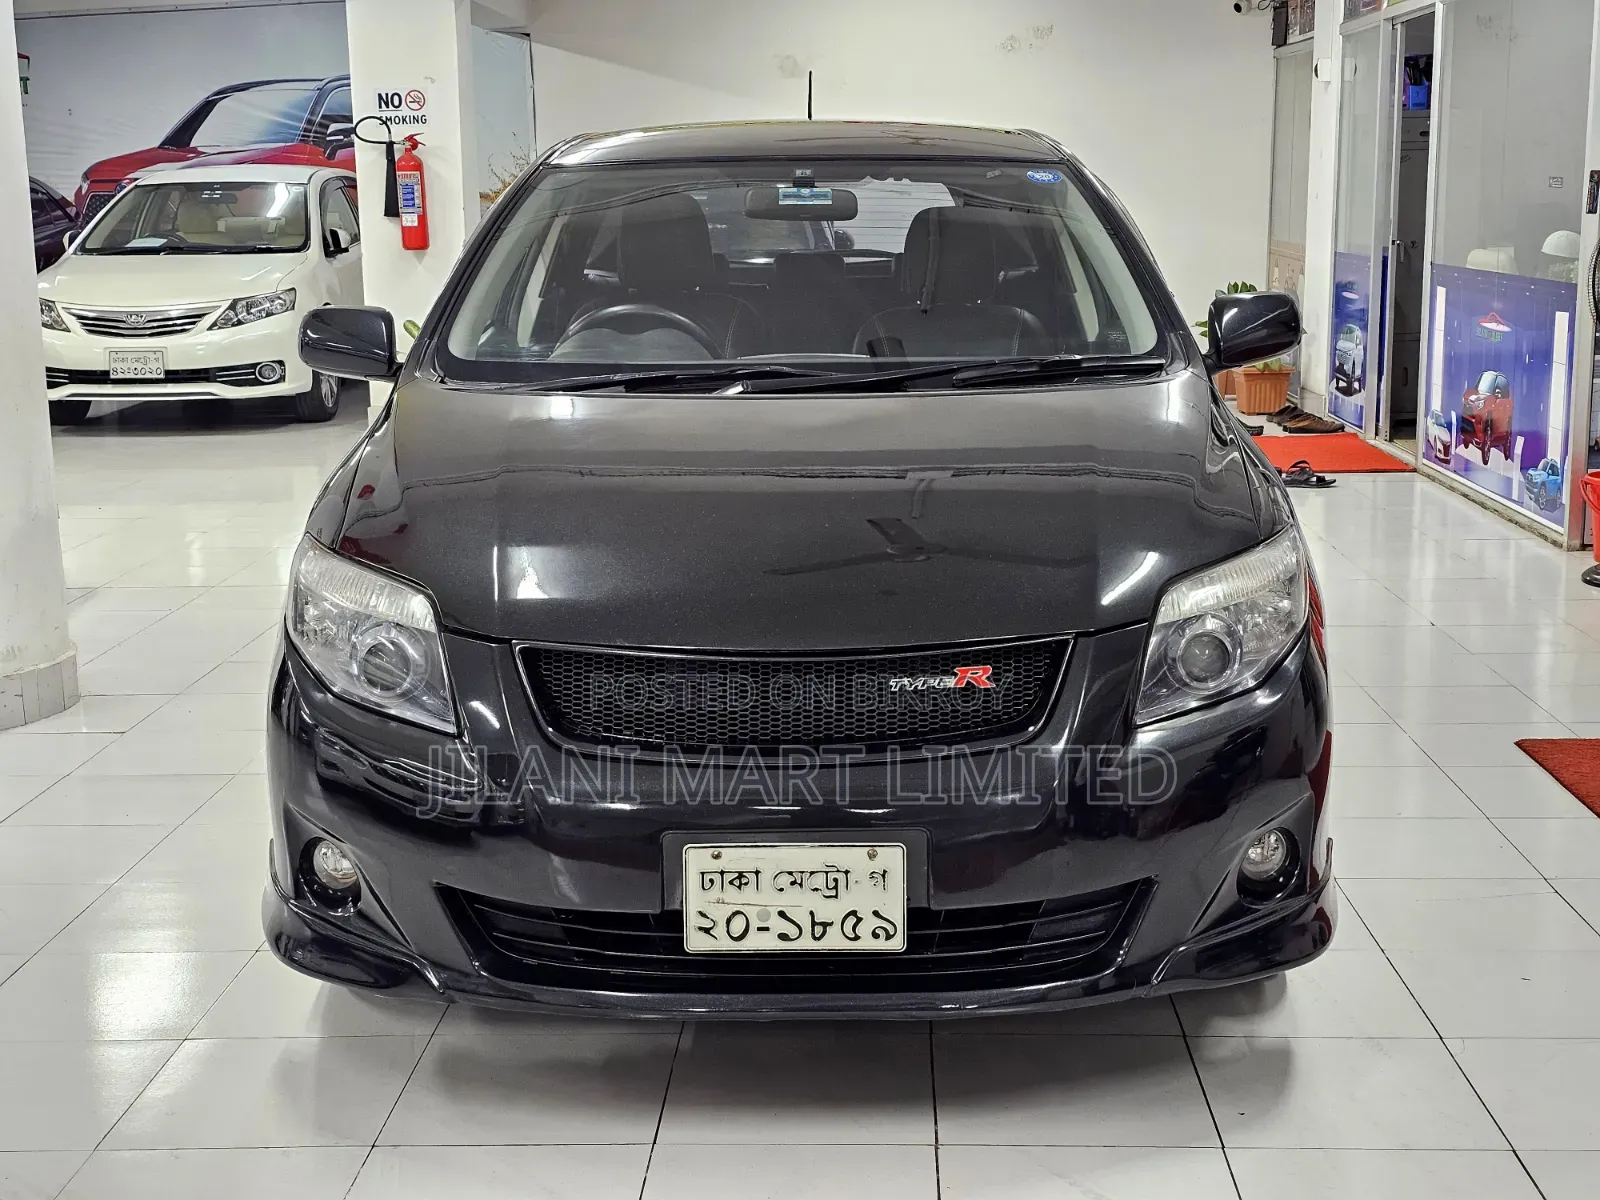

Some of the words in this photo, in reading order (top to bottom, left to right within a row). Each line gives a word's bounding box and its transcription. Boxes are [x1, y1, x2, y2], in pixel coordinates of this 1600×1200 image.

[377, 92, 402, 109] NO
[378, 114, 427, 125] SMOKING
[699, 867, 762, 892] ঢাকা
[694, 909, 898, 942] ২০-১৮৫৯
